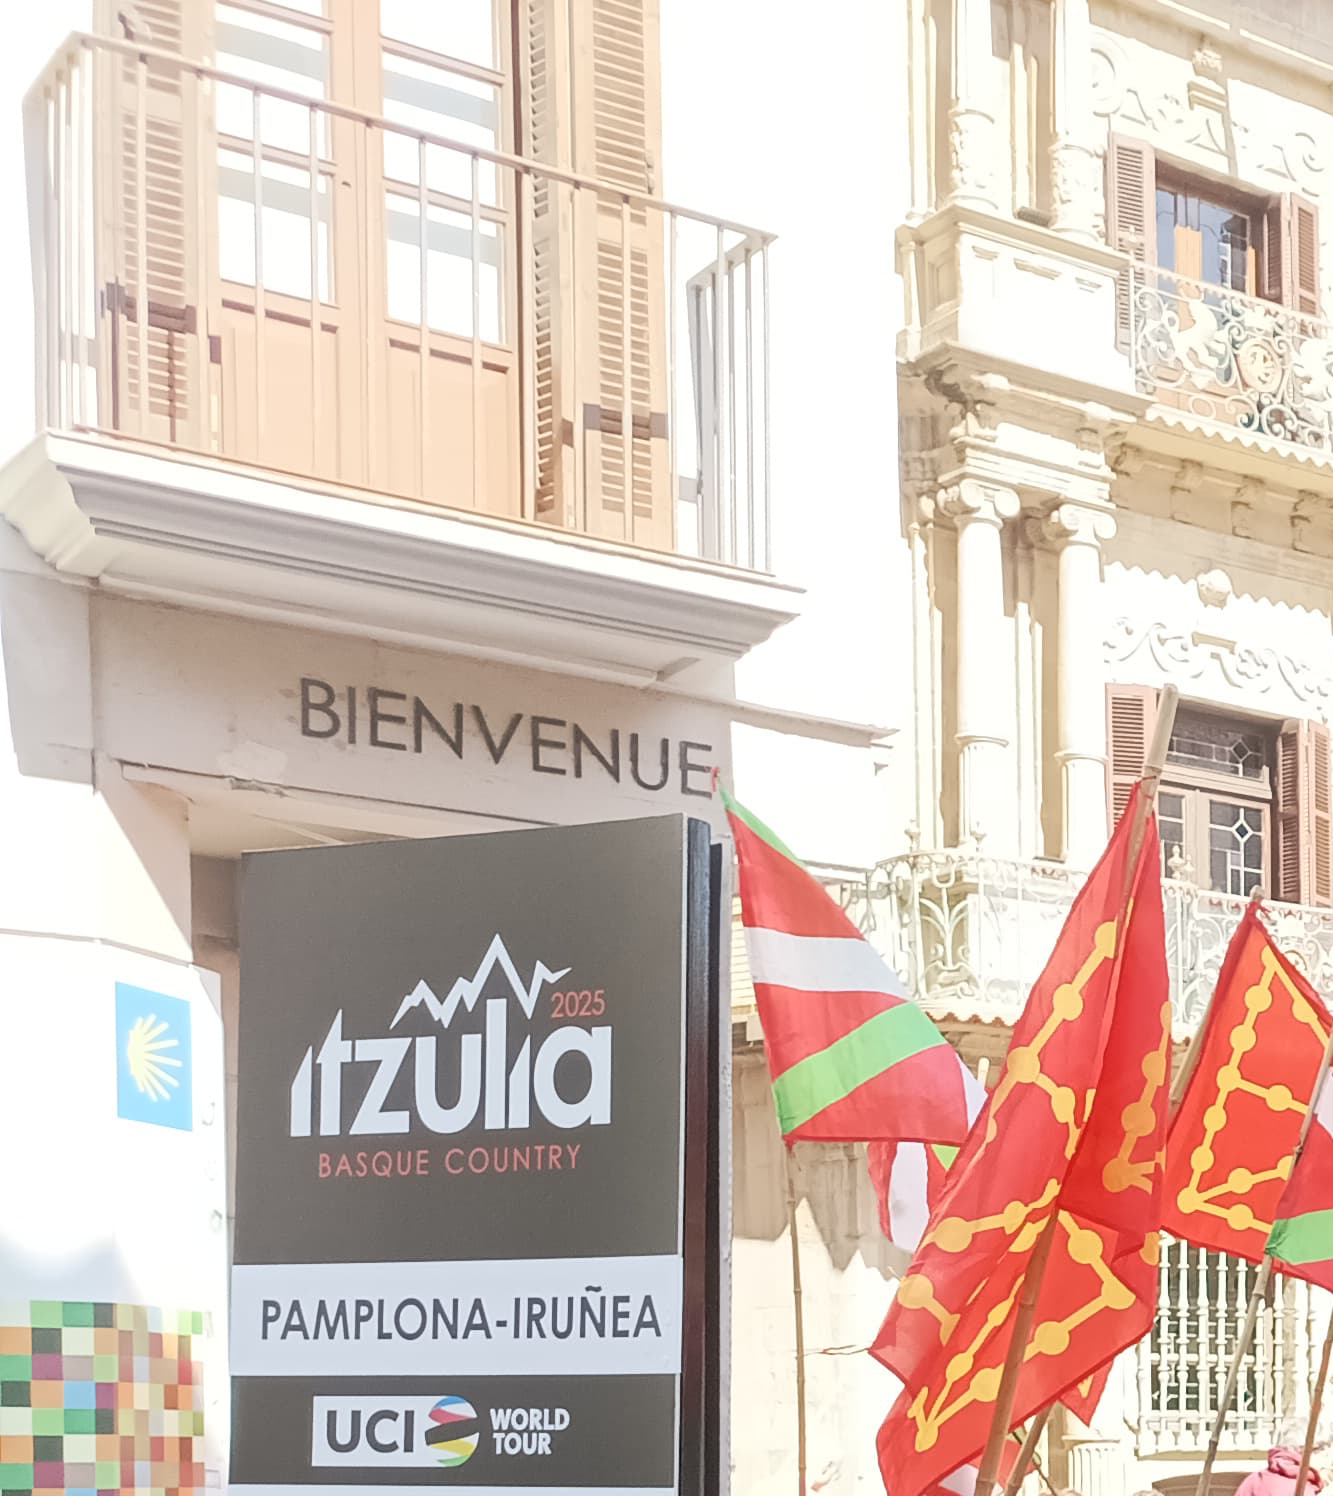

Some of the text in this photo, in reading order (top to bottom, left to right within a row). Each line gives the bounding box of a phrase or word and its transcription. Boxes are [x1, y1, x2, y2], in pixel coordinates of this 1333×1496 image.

[300, 677, 717, 798] BIENVENUE
[550, 990, 606, 1020] 2025
[318, 1143, 581, 1180] BASQUE COUNTRY
[260, 1286, 663, 1342] PAMPLONA-IRUÑEA
[325, 1408, 415, 1456] UCI
[490, 1407, 570, 1433] WORLD
[493, 1431, 552, 1456] TOUR
